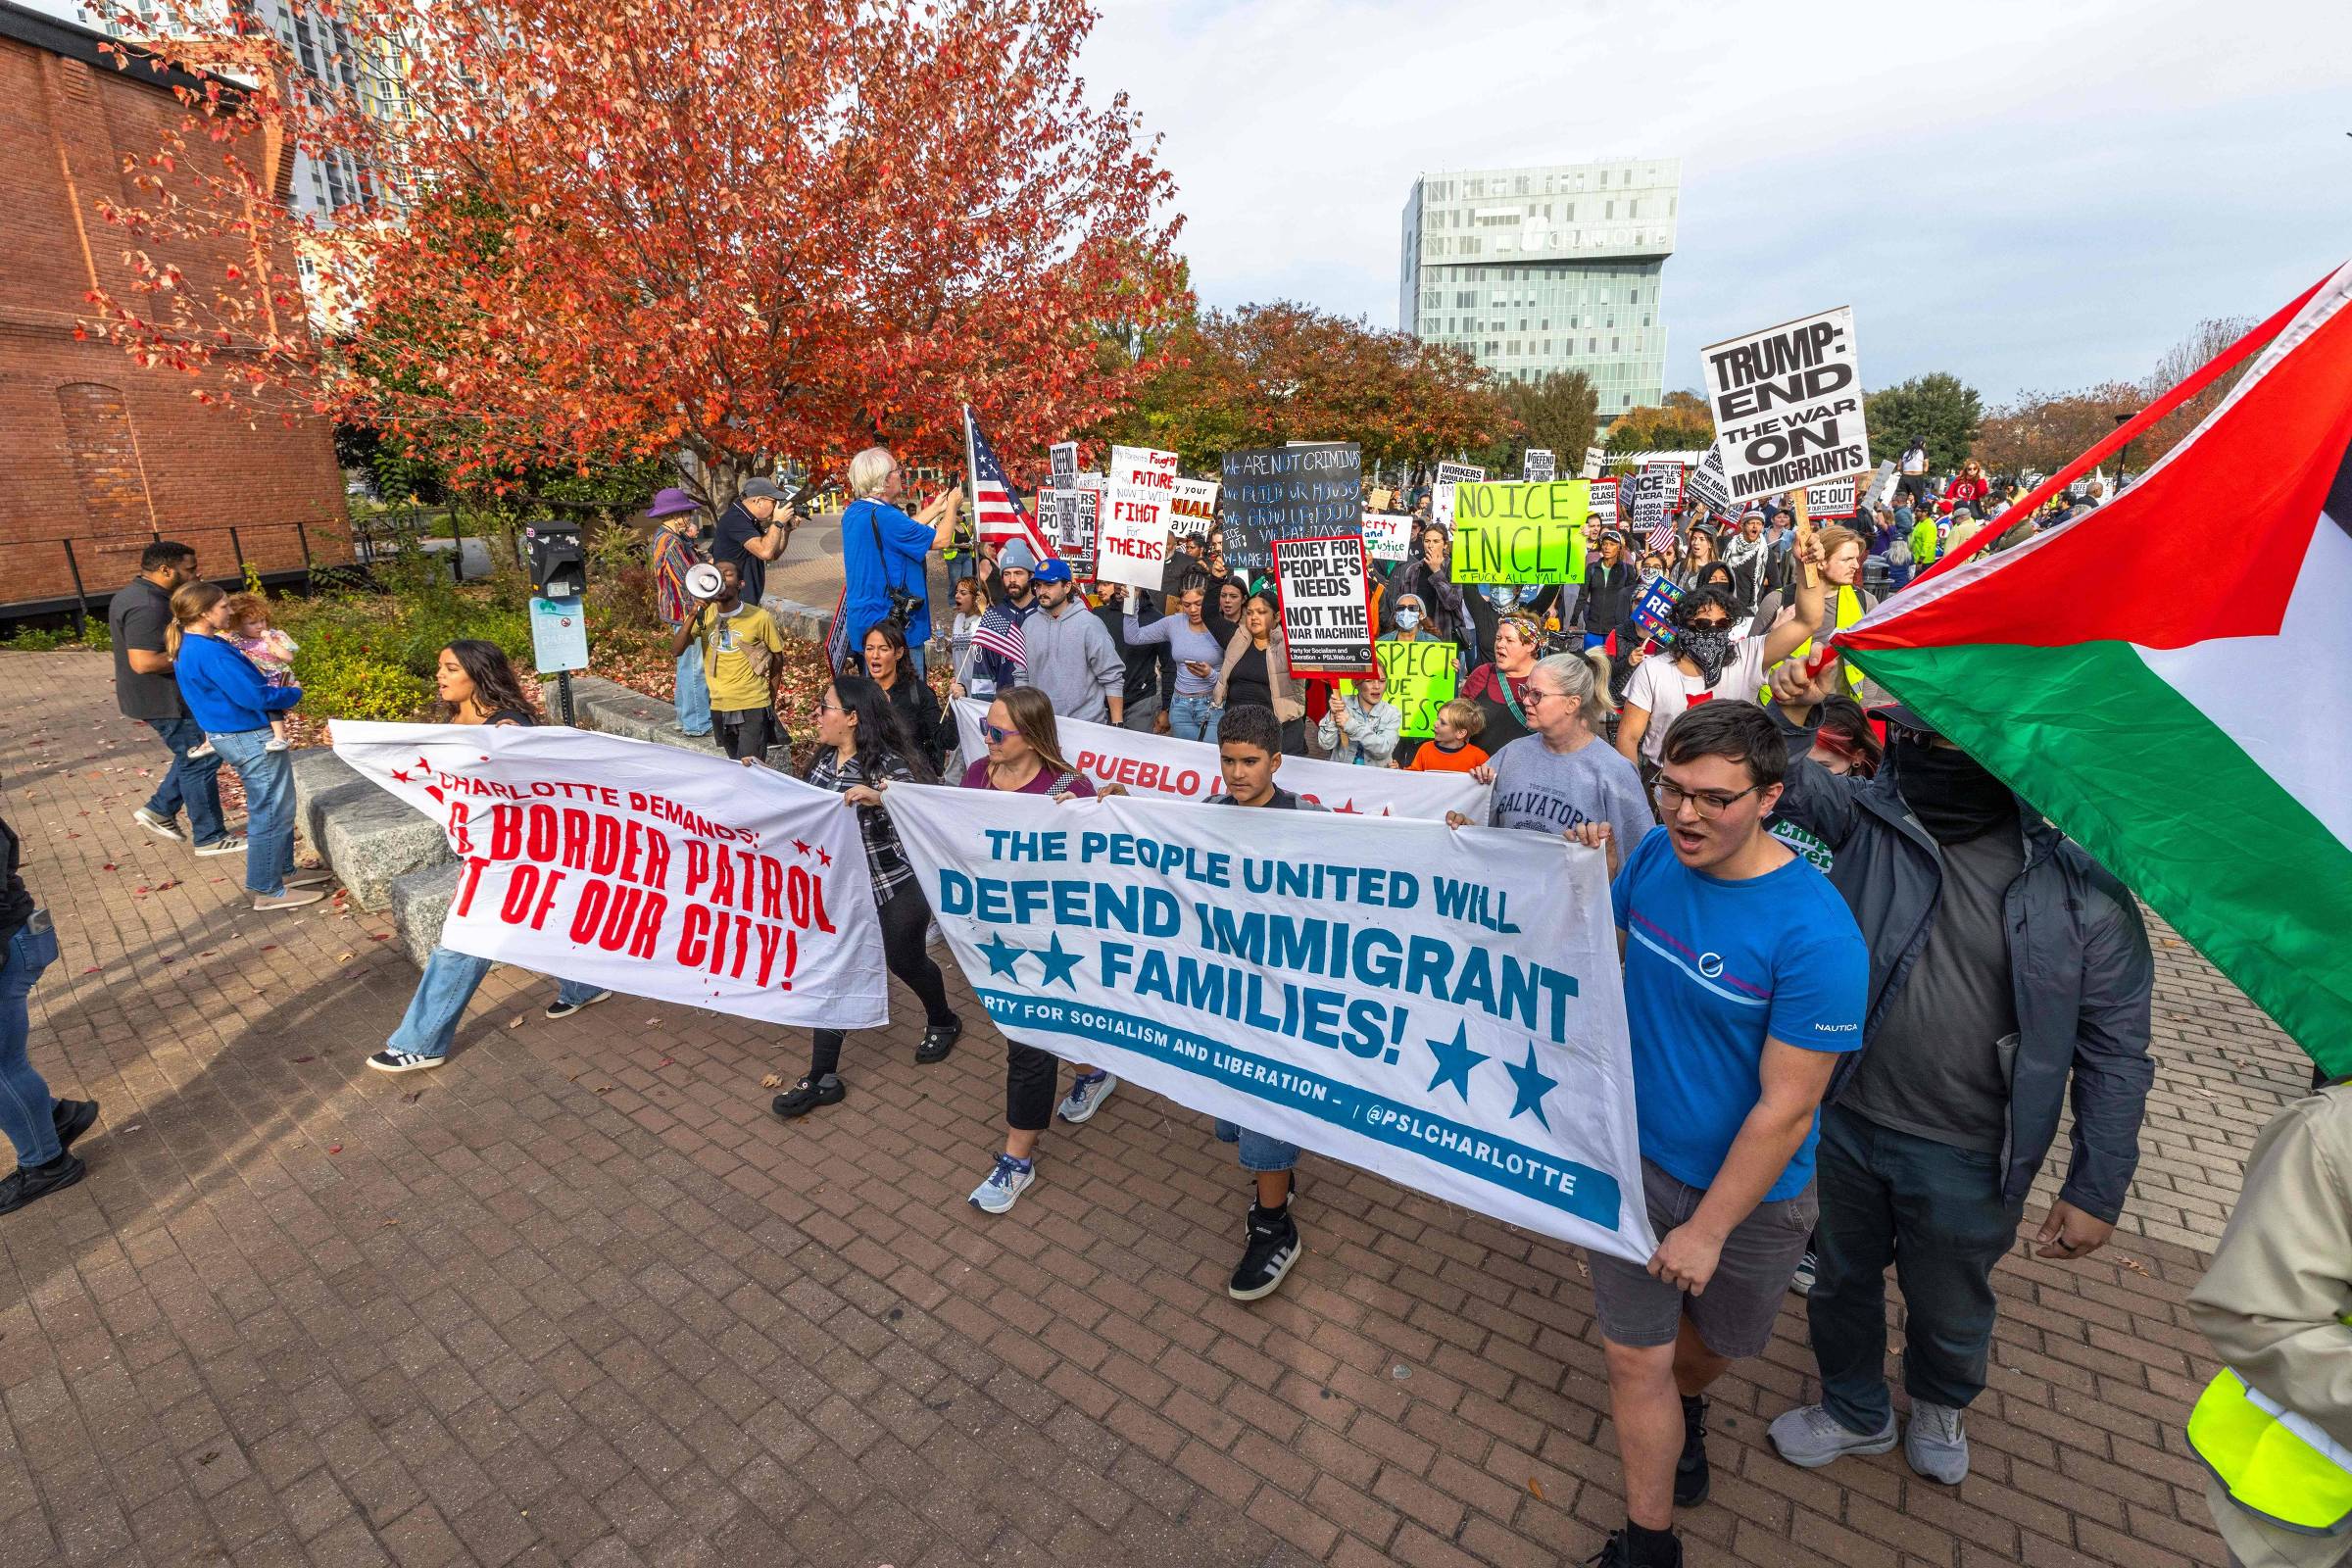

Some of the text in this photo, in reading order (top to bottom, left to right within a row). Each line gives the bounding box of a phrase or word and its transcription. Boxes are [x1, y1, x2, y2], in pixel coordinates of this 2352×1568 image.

[1548, 226, 1667, 248] CHARLOTTE
[1710, 321, 1846, 392] TRUMP:
[1718, 363, 1852, 422] END
[1722, 398, 1856, 444] THE WAR
[1745, 418, 1839, 466] ON
[1113, 448, 1123, 461] My
[1244, 454, 1270, 475] ARE
[1271, 454, 1301, 475] NOT
[1532, 456, 1554, 465] DEFEND
[1132, 470, 1175, 490] FUTURE
[1440, 473, 1464, 482] SHOULD
[1442, 465, 1482, 479] WORKERS
[1695, 469, 1712, 484] NOT
[1732, 444, 1864, 498] IMMIGRANTS
[1636, 475, 1663, 491] ICE
[1665, 487, 1680, 496] THE
[1691, 477, 1729, 505] DEPORTATION!
[1710, 480, 1728, 496] MAS
[1116, 488, 1137, 499] NOW
[1148, 491, 1173, 502] WILL
[1459, 483, 1568, 519] NO ICE
[1807, 487, 1855, 505] ICE OUT
[1114, 502, 1160, 523] FIHGT
[1170, 498, 1213, 520] NIAL
[1171, 519, 1205, 534] ay!!!
[1224, 527, 1242, 540] ICE
[1106, 536, 1163, 561] THEIRS
[1229, 535, 1248, 549] OUT!
[1277, 539, 1359, 559] MONEY FOR
[1365, 539, 1404, 552] Justice
[1458, 524, 1582, 574] IN CLT
[1280, 556, 1362, 578] PEOPLE'S
[1294, 578, 1351, 597] NEEDS
[1471, 572, 1567, 584] FUCK ALL Y'ALL
[1286, 605, 1367, 626] NOT THE
[1646, 595, 1673, 618] RE
[1288, 626, 1369, 640] WAR MACHINE!
[1375, 643, 1456, 679] SPECT
[1388, 678, 1411, 695] UE
[1078, 751, 1200, 796] PUEBLO
[438, 770, 760, 846] CHARLOTTE DEMANDS:
[490, 803, 671, 890] BORDER
[683, 837, 837, 934] PATROL
[985, 829, 1522, 934] THE PEOPLE UNITED WILL
[500, 863, 566, 931] OF
[568, 878, 668, 960] OUR
[676, 903, 799, 992] CITY!
[939, 868, 1581, 1045] DEFEND IMMIGRANT
[1101, 942, 1410, 1068] FAMILIES!
[1815, 1022, 1858, 1032] NAUTICA
[1024, 1004, 1063, 1022] FOR
[1070, 1009, 1168, 1048] SOCIALISM
[1174, 1038, 1209, 1062] AND
[1213, 1051, 1328, 1101] LIBERATION
[1366, 1103, 1577, 1197] @PSLCHARLOTTE
